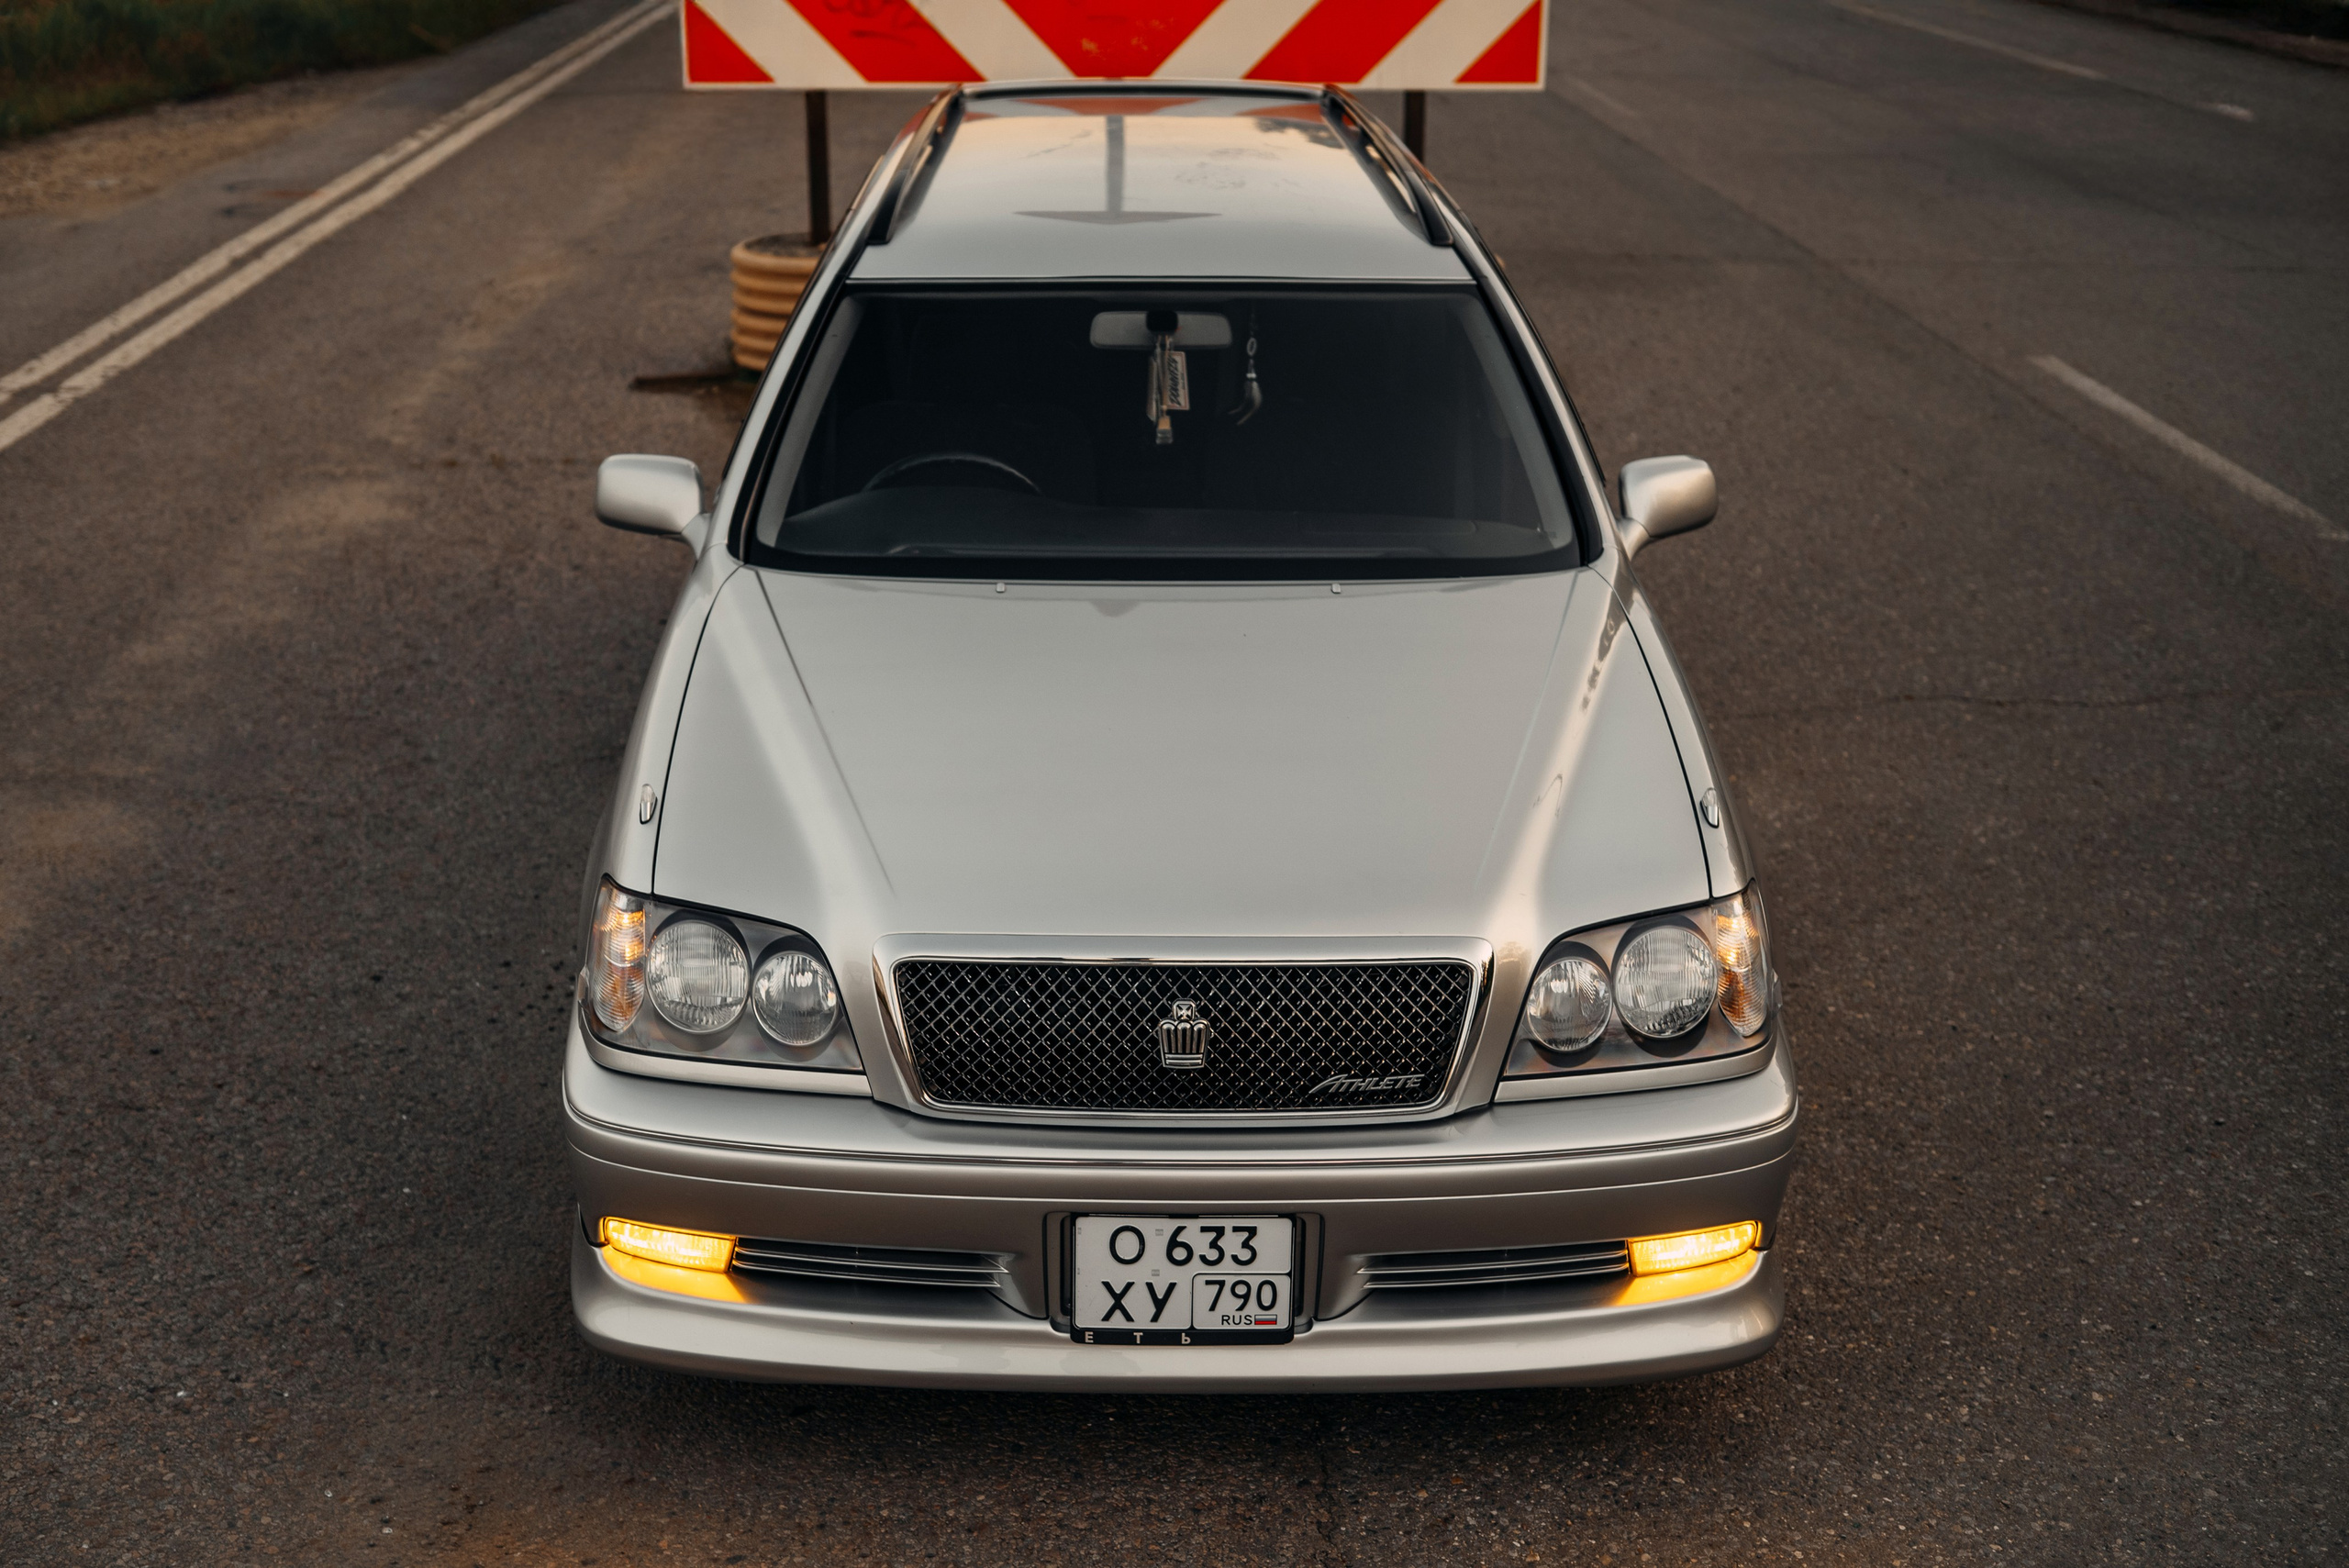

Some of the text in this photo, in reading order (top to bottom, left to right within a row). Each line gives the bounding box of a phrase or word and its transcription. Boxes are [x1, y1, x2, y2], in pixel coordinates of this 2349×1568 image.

[1308, 1073, 1425, 1094] ATHLETE
[1165, 1225, 1258, 1267] 633
[1204, 1279, 1278, 1312] 790
[1220, 1314, 1253, 1326] RUS
